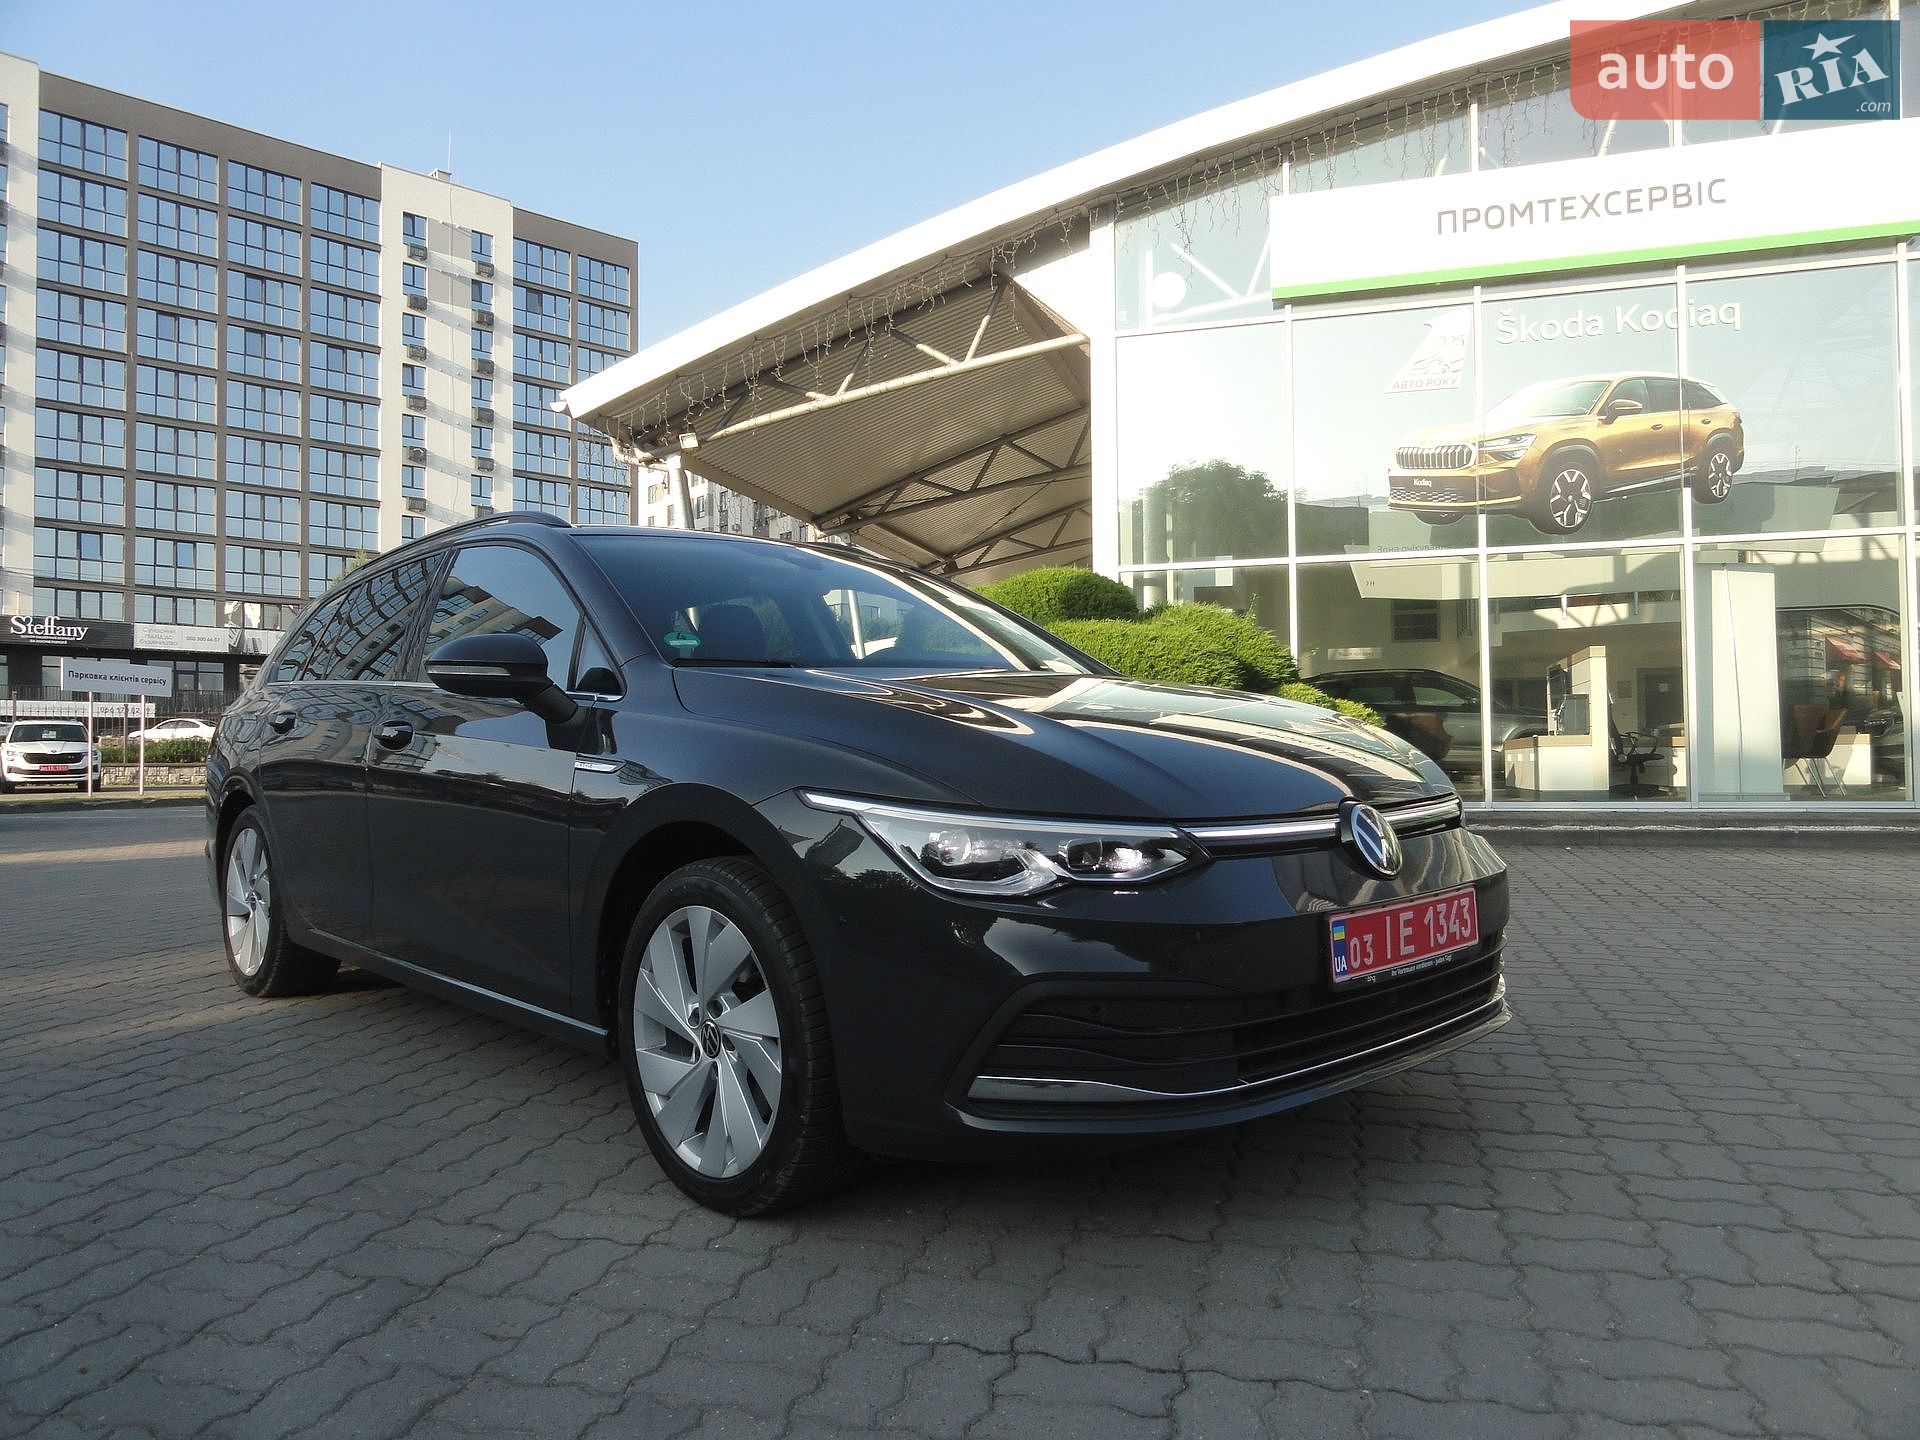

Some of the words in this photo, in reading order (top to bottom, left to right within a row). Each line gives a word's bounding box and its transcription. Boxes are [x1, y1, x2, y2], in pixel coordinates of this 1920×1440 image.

[1437, 178, 1727, 235] ПРОМТЕХСЕРВІС
[1496, 308, 1604, 345] Škoda
[1392, 380, 1423, 390] АВТО
[1424, 377, 1457, 387] РОКУ
[1413, 478, 1432, 488] Kodiaq
[10, 615, 89, 641] Steffany
[68, 670, 107, 680] Парковка
[109, 674, 139, 683] клієнтів
[141, 676, 167, 686] сервісу
[1350, 933, 1374, 969] 03
[1385, 912, 1415, 960] IE
[1424, 897, 1472, 948] 1343
[1334, 955, 1347, 973] UA
